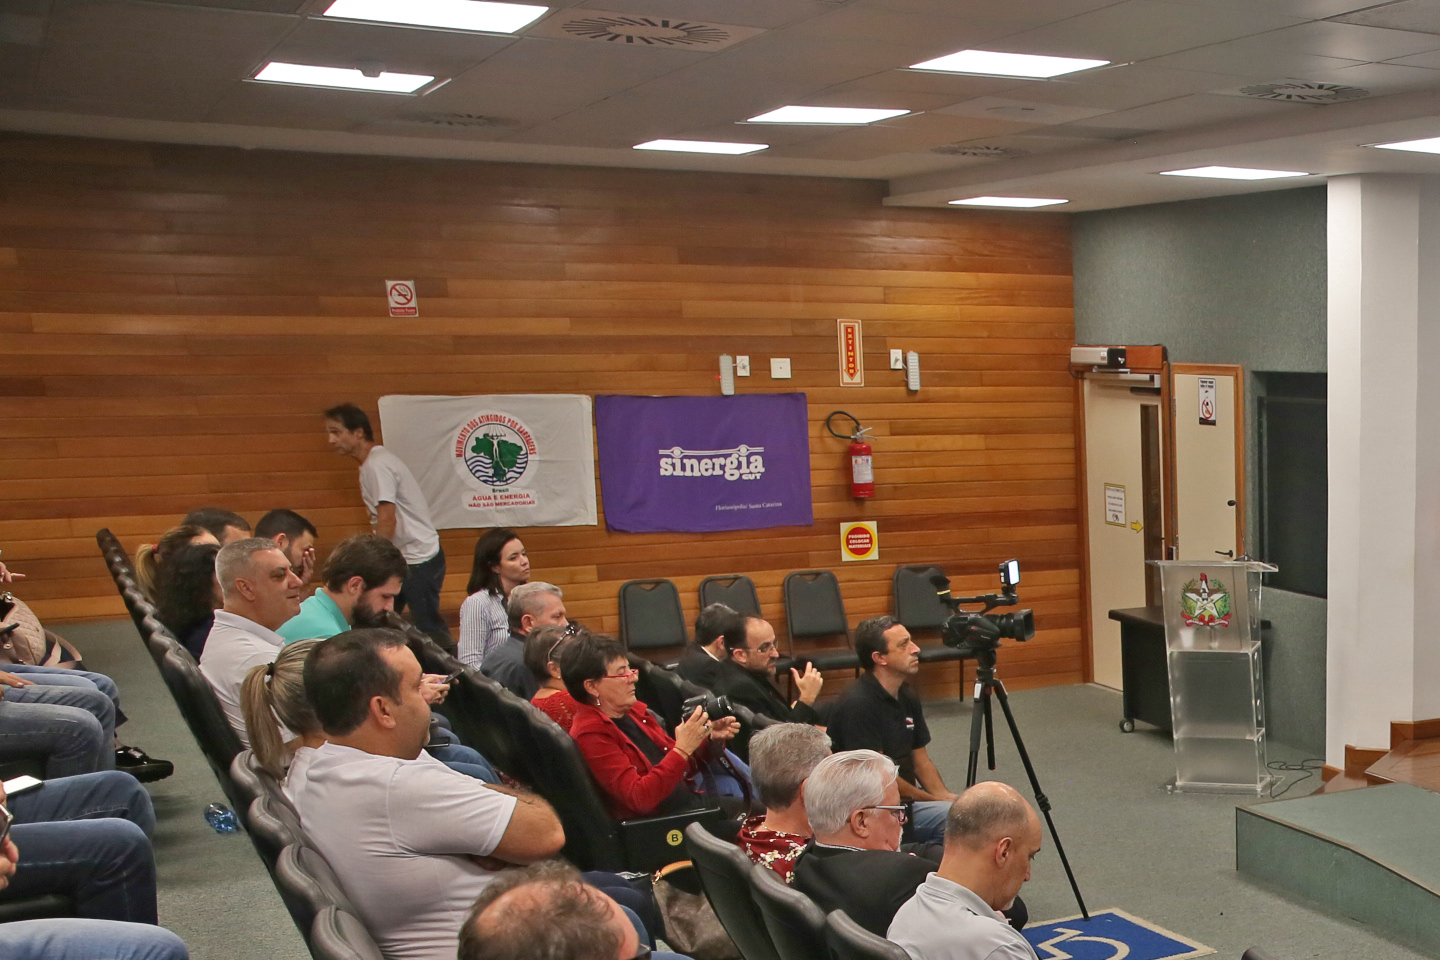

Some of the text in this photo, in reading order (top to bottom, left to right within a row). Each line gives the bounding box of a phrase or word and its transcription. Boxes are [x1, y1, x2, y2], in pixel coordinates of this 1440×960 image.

[467, 418, 479, 432] DOS
[478, 414, 506, 424] ATINGIDOS
[660, 453, 766, 481] sinergia
